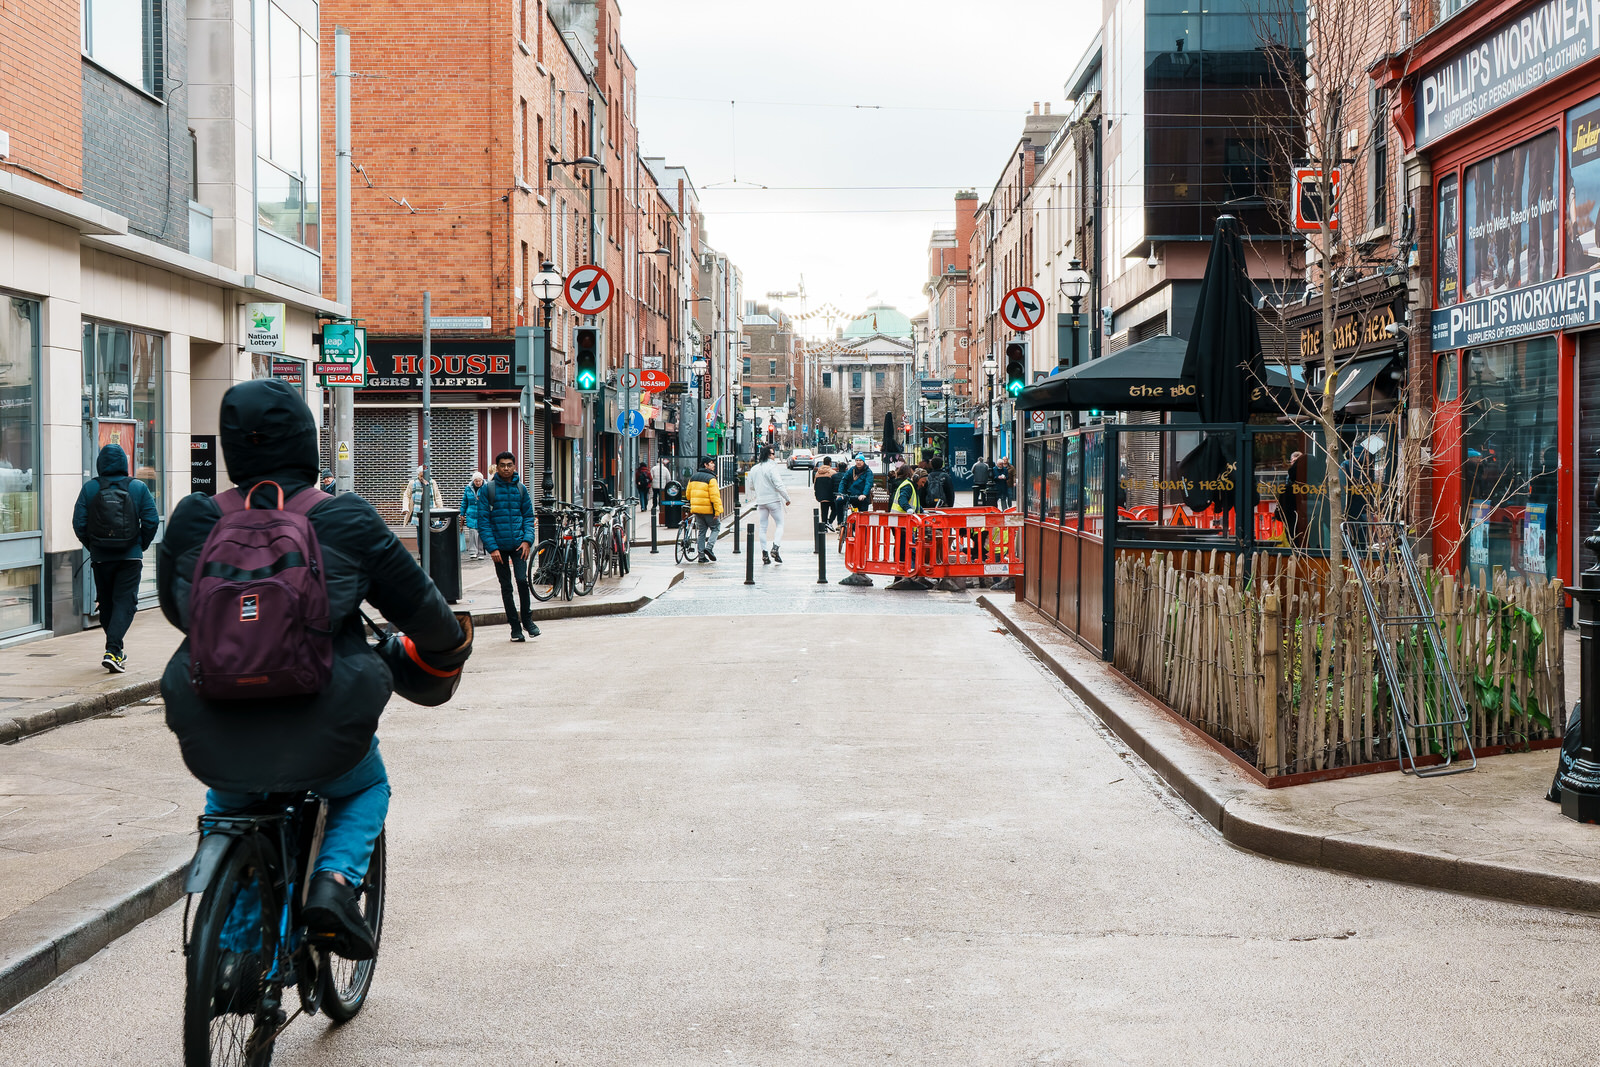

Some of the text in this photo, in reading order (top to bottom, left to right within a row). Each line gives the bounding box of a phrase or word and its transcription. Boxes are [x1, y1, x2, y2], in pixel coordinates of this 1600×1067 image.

[1423, 43, 1491, 138] PHILLIPS
[1444, 38, 1587, 129] SUPPLIERS OF PERSONALISED CLOTHING
[1469, 195, 1557, 240] Ready to Wear, Ready to Work
[1450, 297, 1508, 346] PHILLIPS
[1467, 329, 1495, 344] SUPPLIERS
[1496, 327, 1504, 338] OF
[1505, 319, 1550, 337] PERSONALISED
[1551, 311, 1585, 328] CLOTHING
[250, 339, 277, 348] Lottery
[324, 337, 343, 348] Leap
[392, 354, 510, 375] HOUSE
[367, 377, 410, 387] GERS
